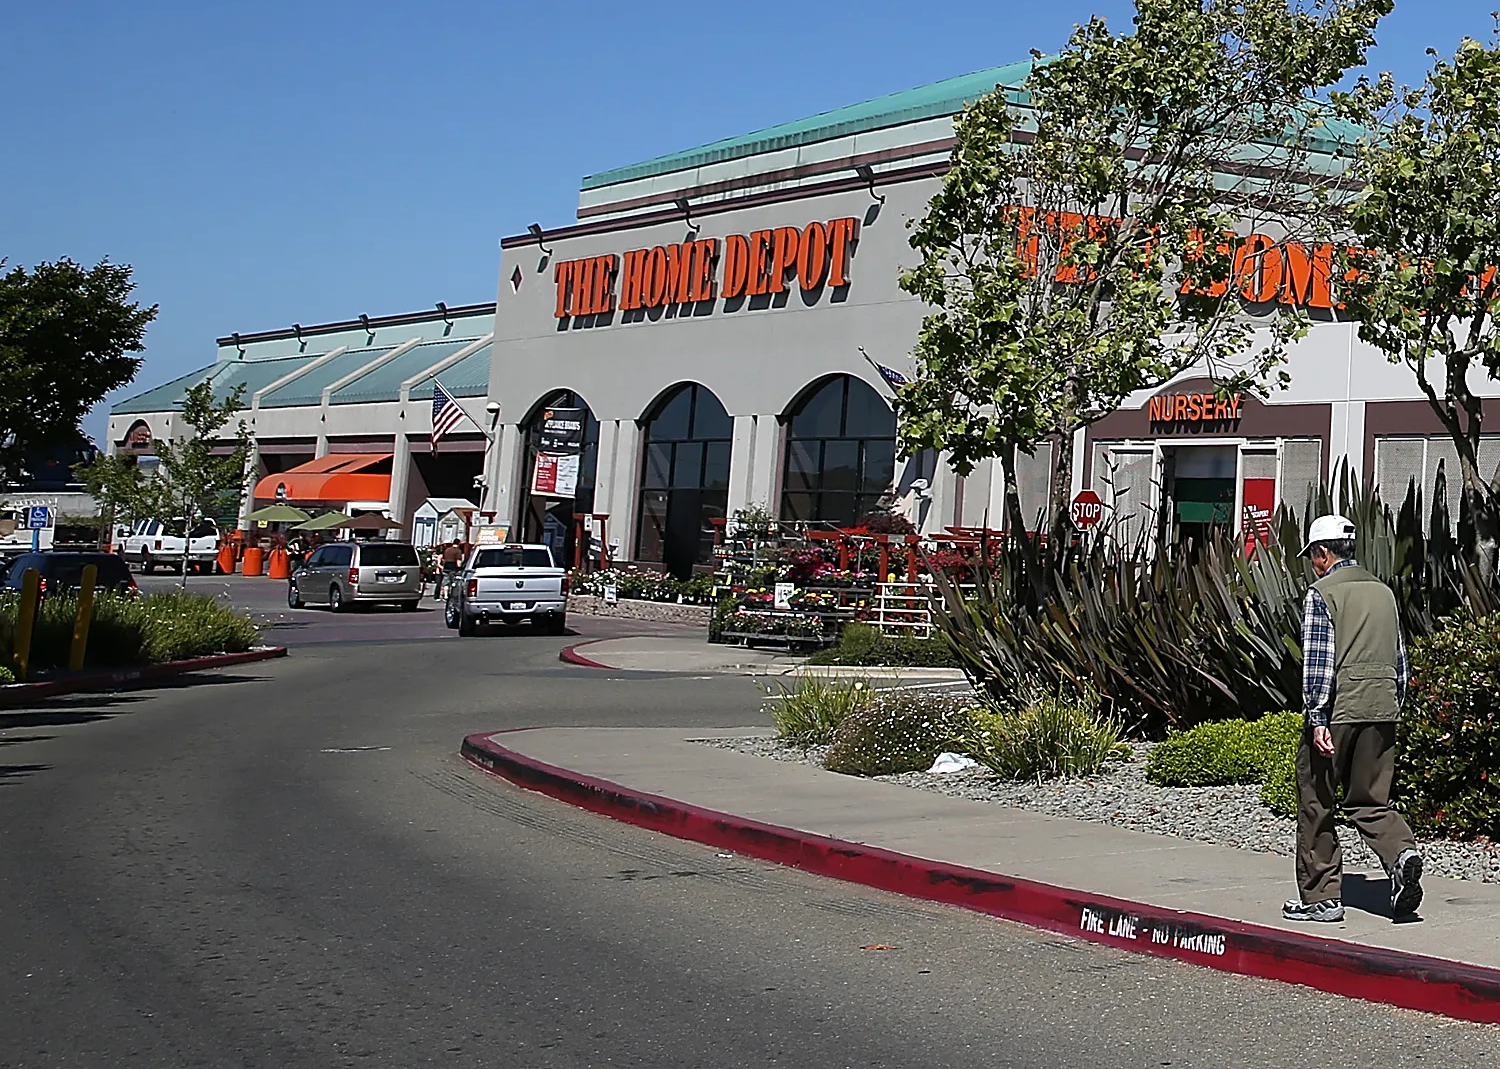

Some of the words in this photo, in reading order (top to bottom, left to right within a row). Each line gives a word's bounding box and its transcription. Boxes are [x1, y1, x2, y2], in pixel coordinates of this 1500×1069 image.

[554, 254, 618, 318] THE
[619, 238, 718, 311] HOME
[721, 217, 857, 299] DEPOT
[1149, 393, 1242, 421] NURSERY
[1073, 502, 1101, 518] STOP
[1081, 908, 1104, 934] FIRE
[1108, 915, 1138, 940] LANE
[1152, 921, 1169, 944] NO
[1173, 927, 1225, 955] PARKING
